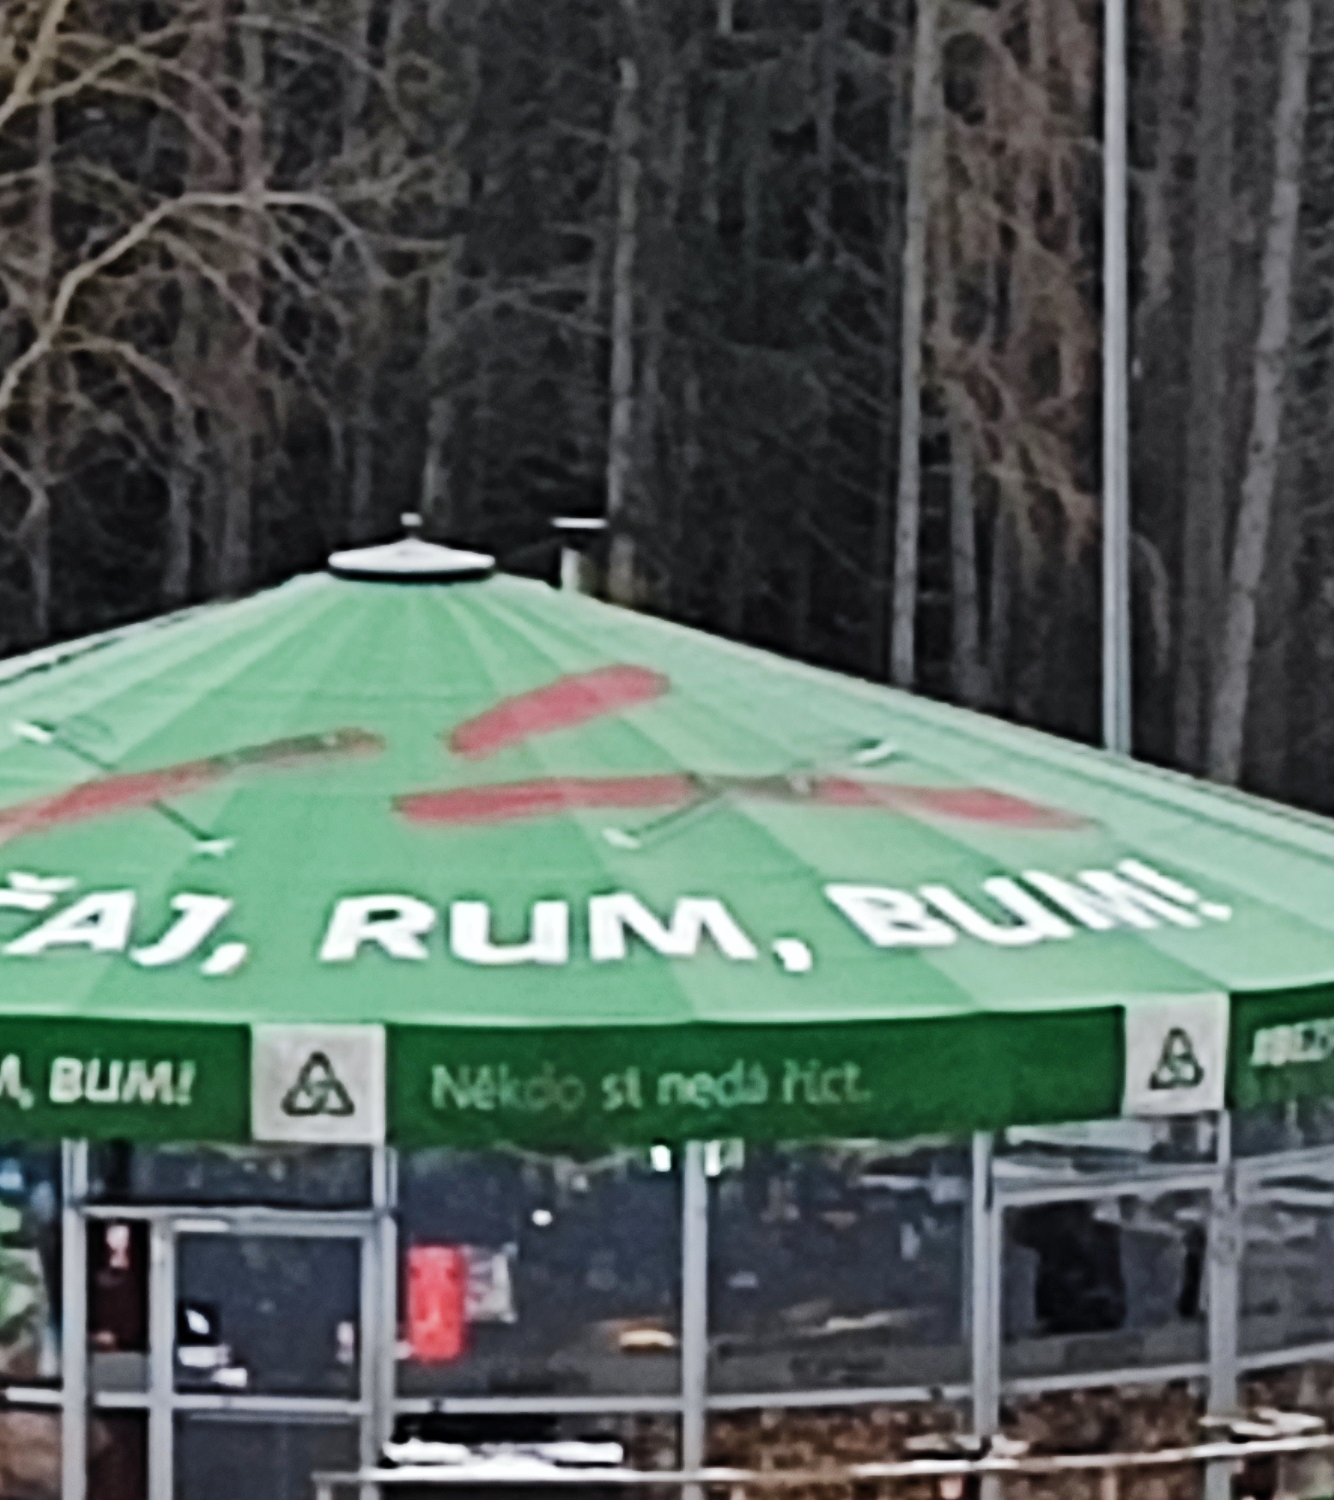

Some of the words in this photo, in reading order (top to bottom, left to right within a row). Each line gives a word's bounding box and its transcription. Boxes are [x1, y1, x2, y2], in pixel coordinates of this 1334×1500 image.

[317, 893, 814, 974] RUM,
[823, 857, 1234, 947] BUM!
[48, 1055, 198, 1107] BUM!
